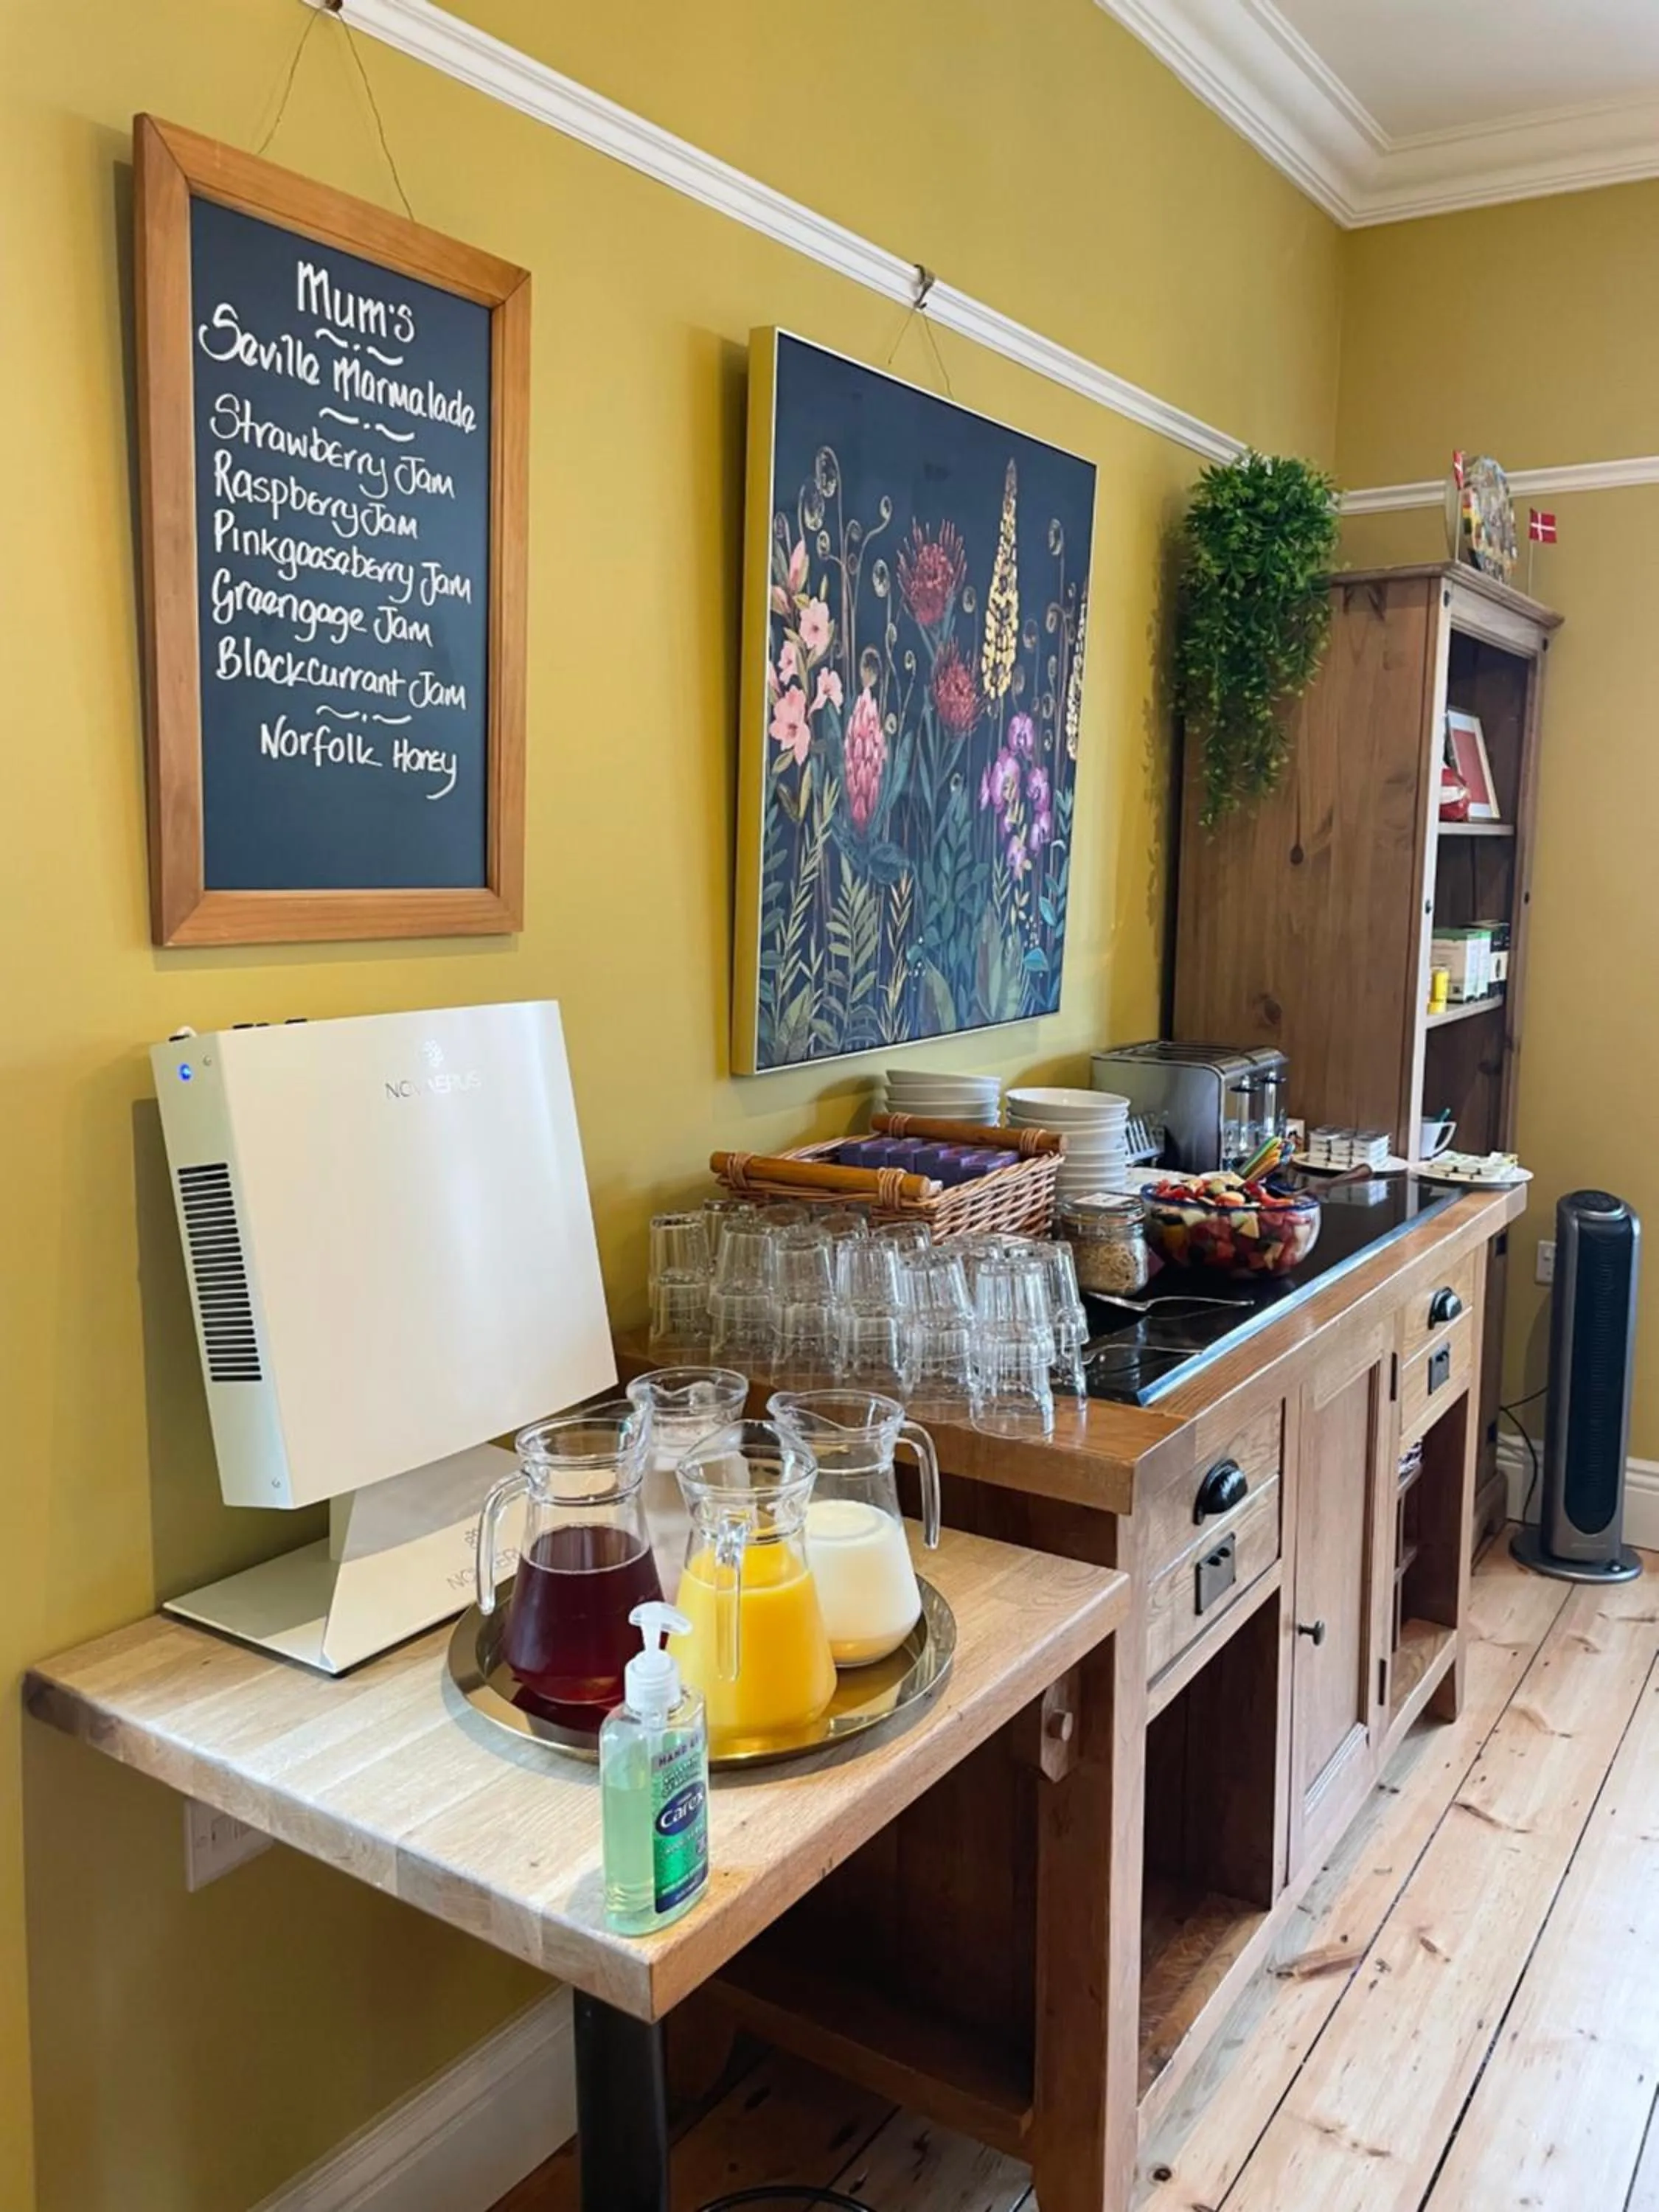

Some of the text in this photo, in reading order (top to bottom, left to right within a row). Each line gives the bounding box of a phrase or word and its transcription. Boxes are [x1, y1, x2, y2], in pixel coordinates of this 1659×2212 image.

[297, 260, 415, 343] Mum's
[198, 302, 478, 434] Seville Marmalade
[209, 393, 456, 499] Strawberry Jam
[214, 449, 418, 540] Raspberry Jam
[210, 567, 434, 647] Greengage Jam
[420, 562, 472, 606] Jam
[215, 636, 467, 710] Blackcurrant Jam
[260, 714, 458, 800] Norfolk Honey
[384, 1070, 481, 1099] NOERUS
[661, 1790, 703, 1828] Carex
